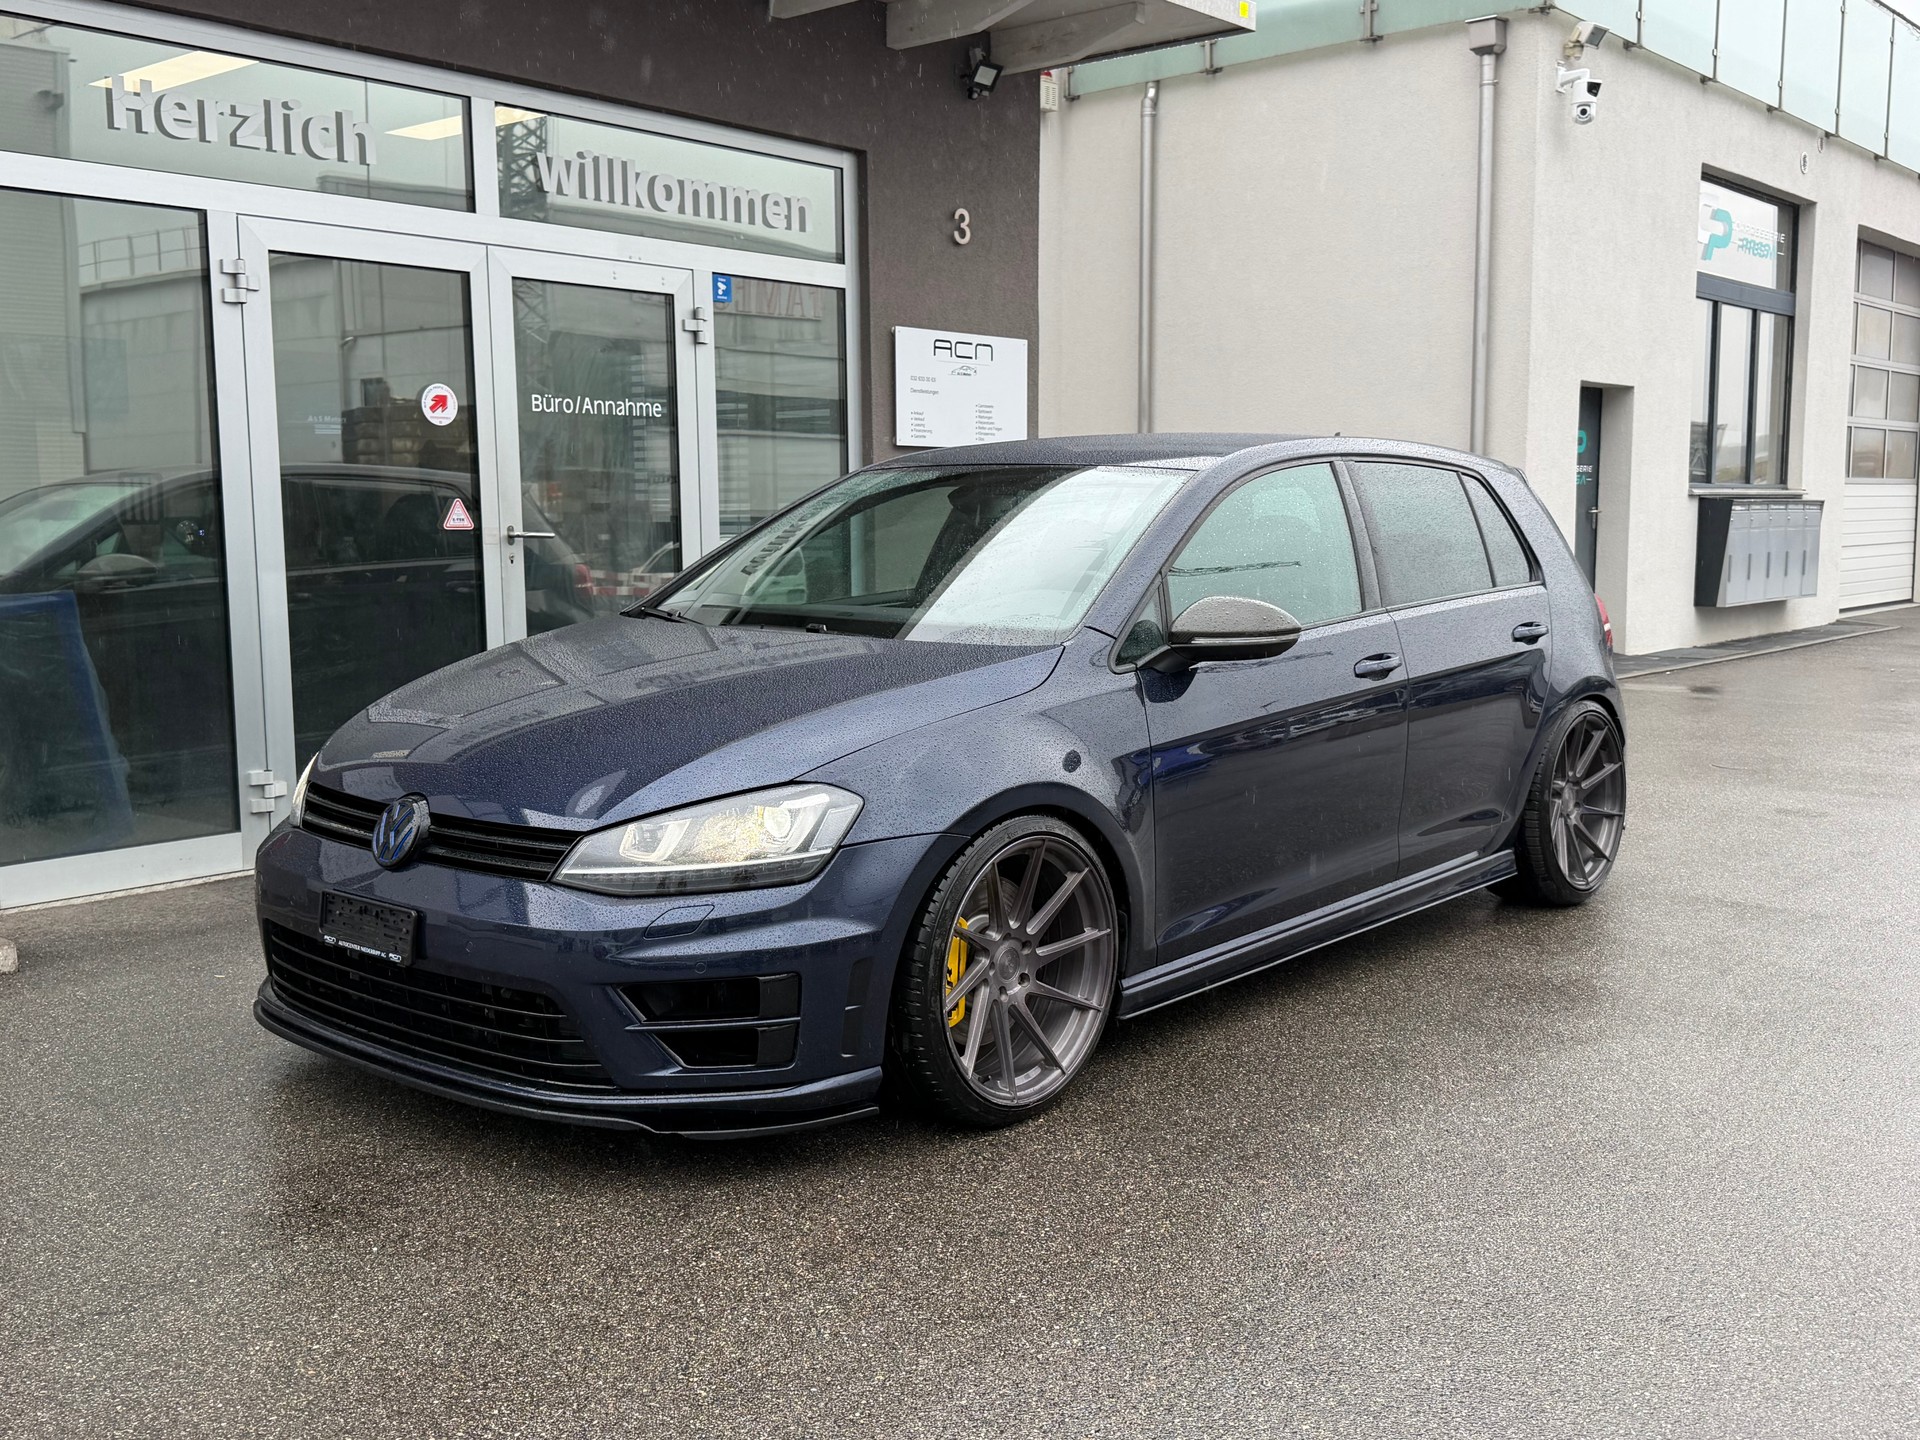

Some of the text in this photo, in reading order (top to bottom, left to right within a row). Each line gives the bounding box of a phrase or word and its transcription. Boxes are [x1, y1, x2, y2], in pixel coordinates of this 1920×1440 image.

[105, 74, 377, 165] Herzlich
[953, 208, 971, 246] 3
[933, 339, 993, 361] ACN
[531, 393, 662, 418] Büro/Annahme
